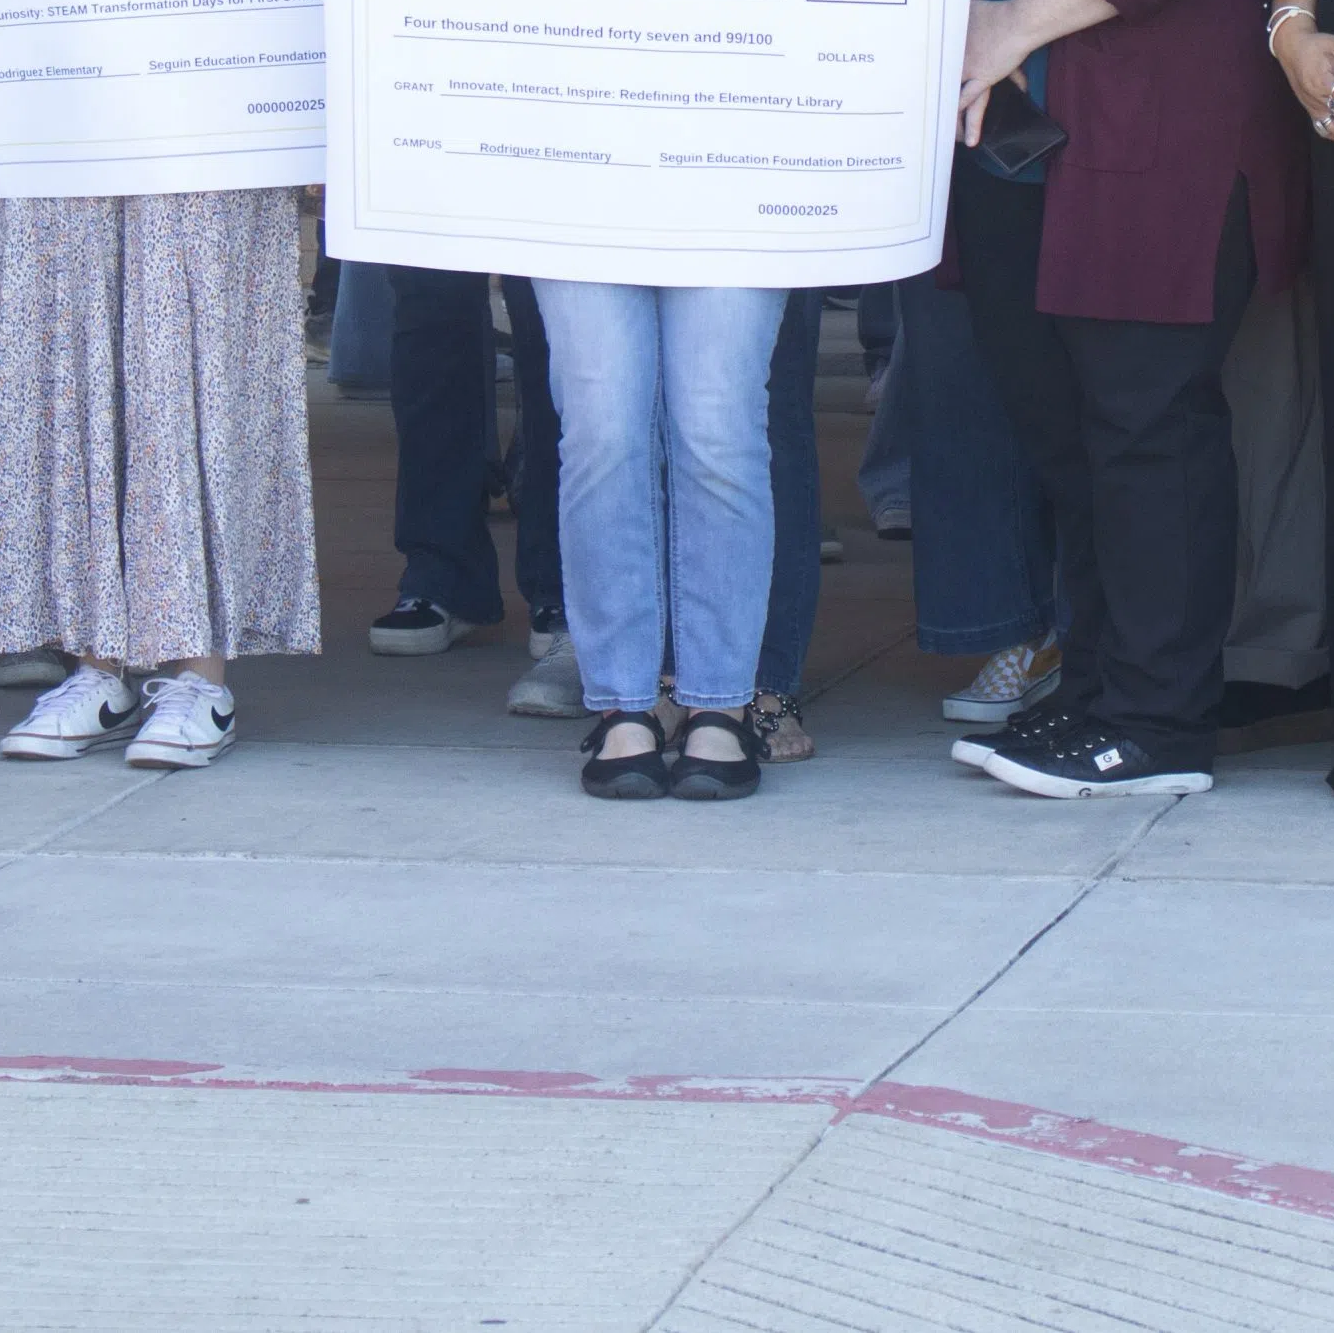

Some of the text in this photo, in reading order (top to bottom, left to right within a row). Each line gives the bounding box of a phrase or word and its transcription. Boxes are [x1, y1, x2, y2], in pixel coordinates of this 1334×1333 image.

[48, 4, 88, 16] STEAM
[405, 16, 772, 45] Four thousand one hundred forty seven and 99/100
[46, 66, 102, 77] Elementary
[149, 59, 190, 72] Seguin
[195, 55, 255, 67] Education
[259, 50, 326, 63] Foundation
[818, 52, 874, 62] DOLLARS
[394, 79, 843, 109] GRANT Innovate, Interact, Inspire: Redefining the Elementary Library
[248, 99, 325, 114] 0000002025
[394, 138, 902, 167] CAMPUS Rodriguez Elementary Seguin Education Foundation Directors
[758, 204, 838, 216] 0000002025
